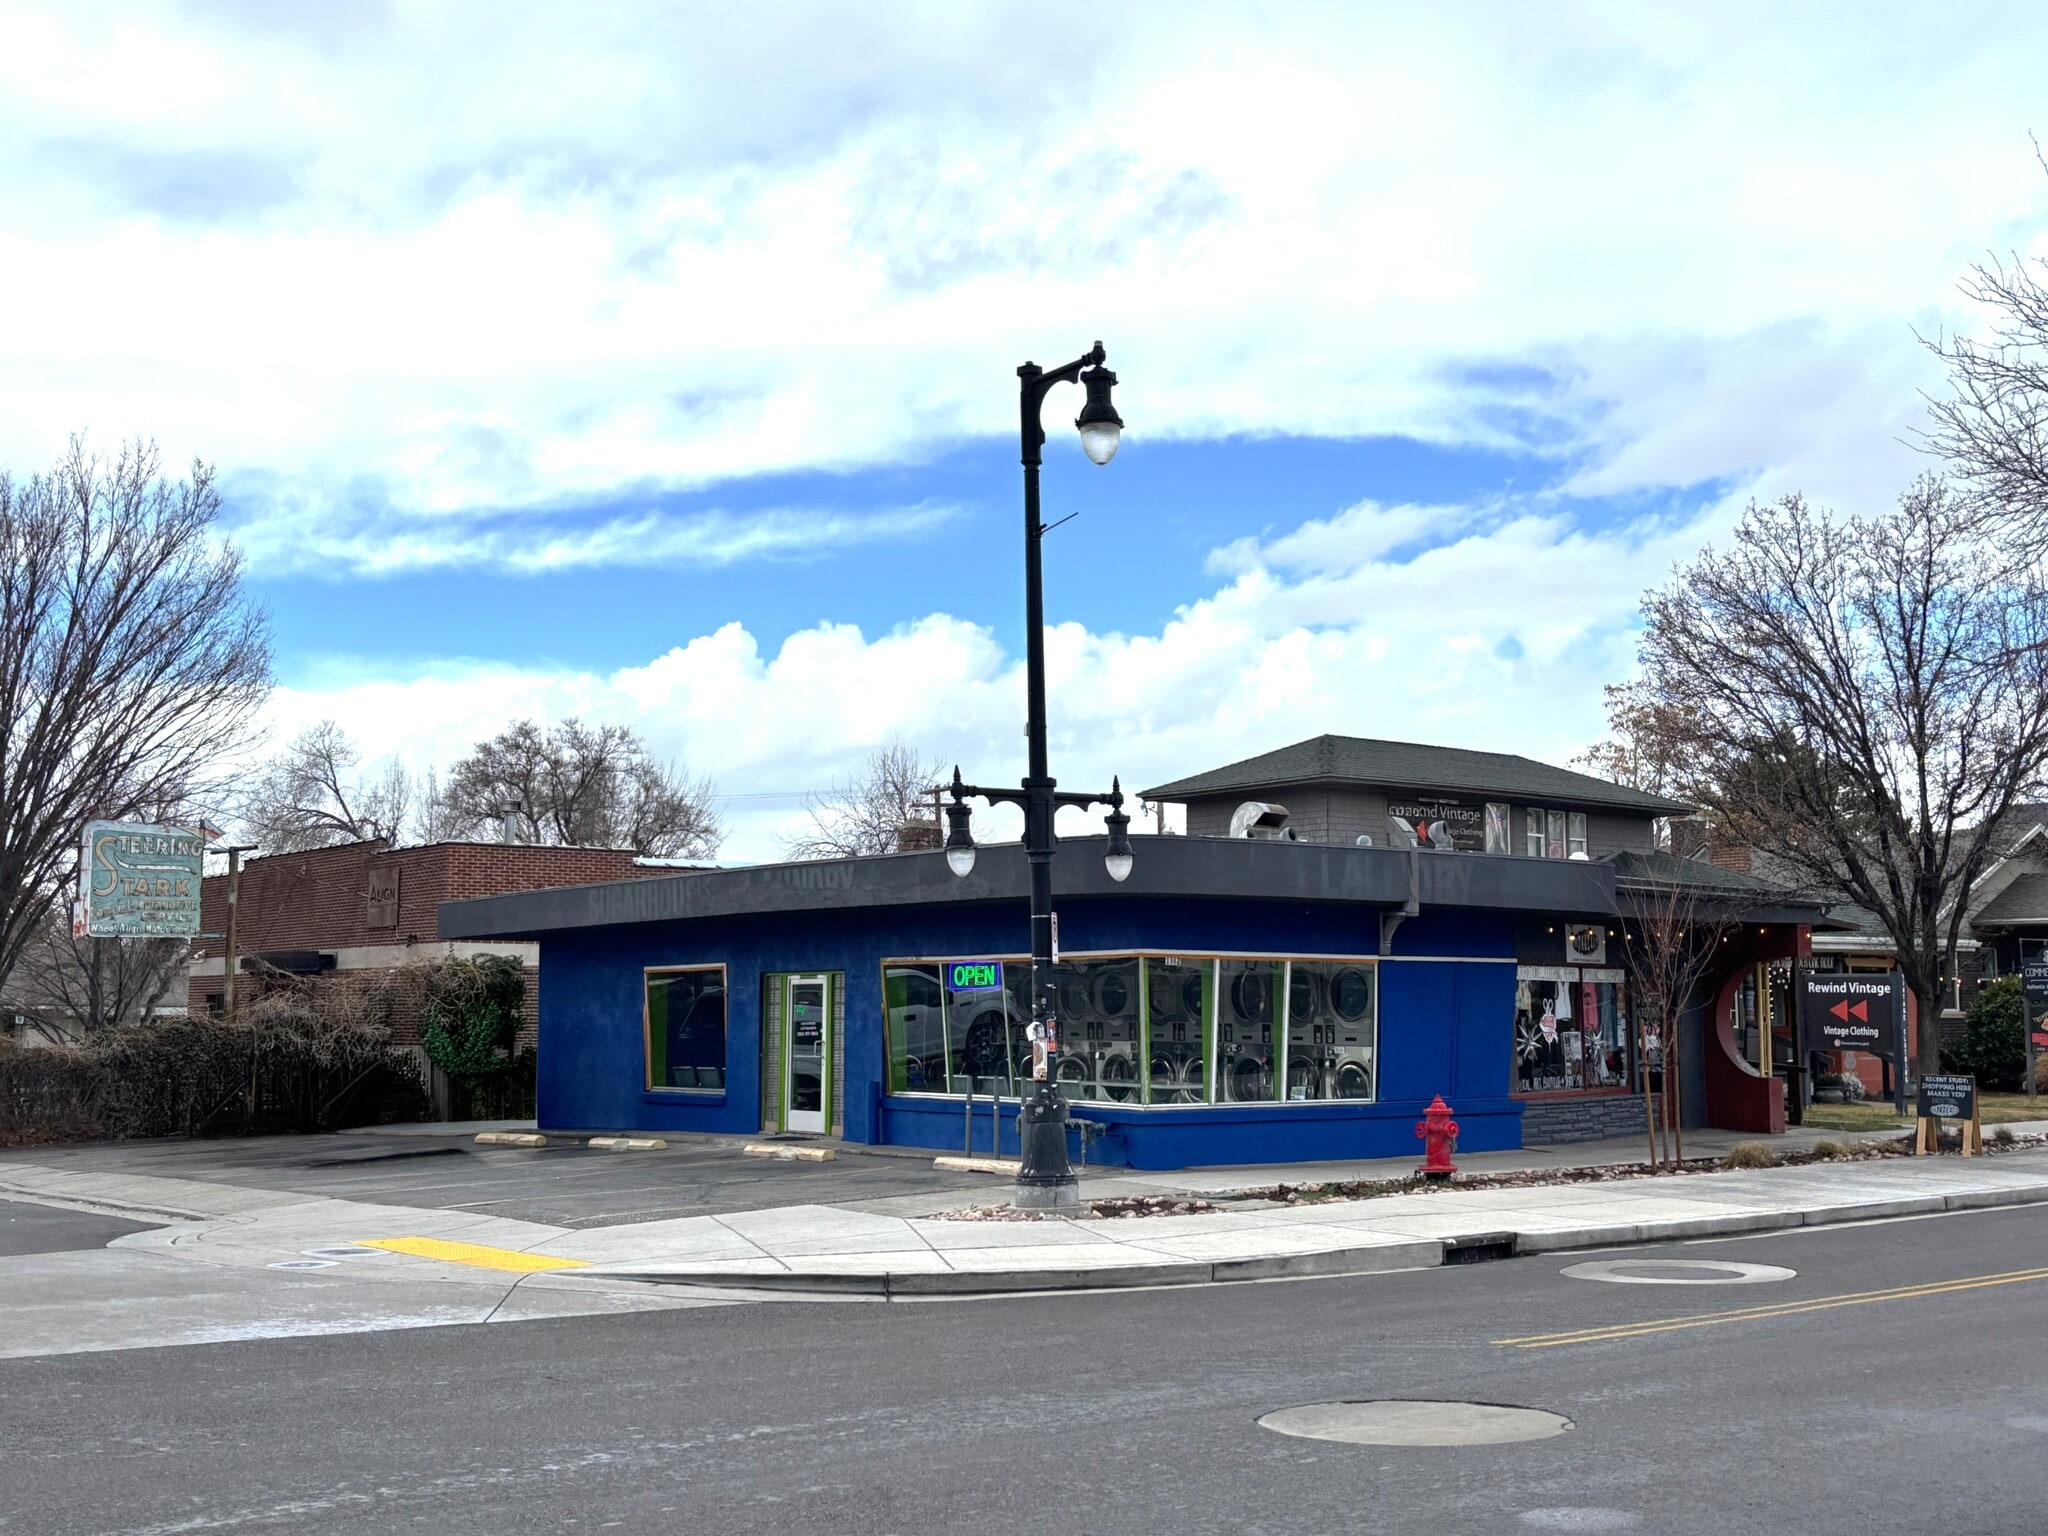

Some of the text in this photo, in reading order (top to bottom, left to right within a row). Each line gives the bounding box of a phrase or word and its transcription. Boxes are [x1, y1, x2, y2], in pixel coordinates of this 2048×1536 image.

[1440, 805, 1481, 824] Vintage
[142, 912, 192, 922] SERVICE
[90, 924, 117, 933] Wheel
[954, 965, 995, 986] OPEN
[1808, 981, 1891, 996] Rewind Vintage
[1823, 1025, 1879, 1038] Vintage Clothing
